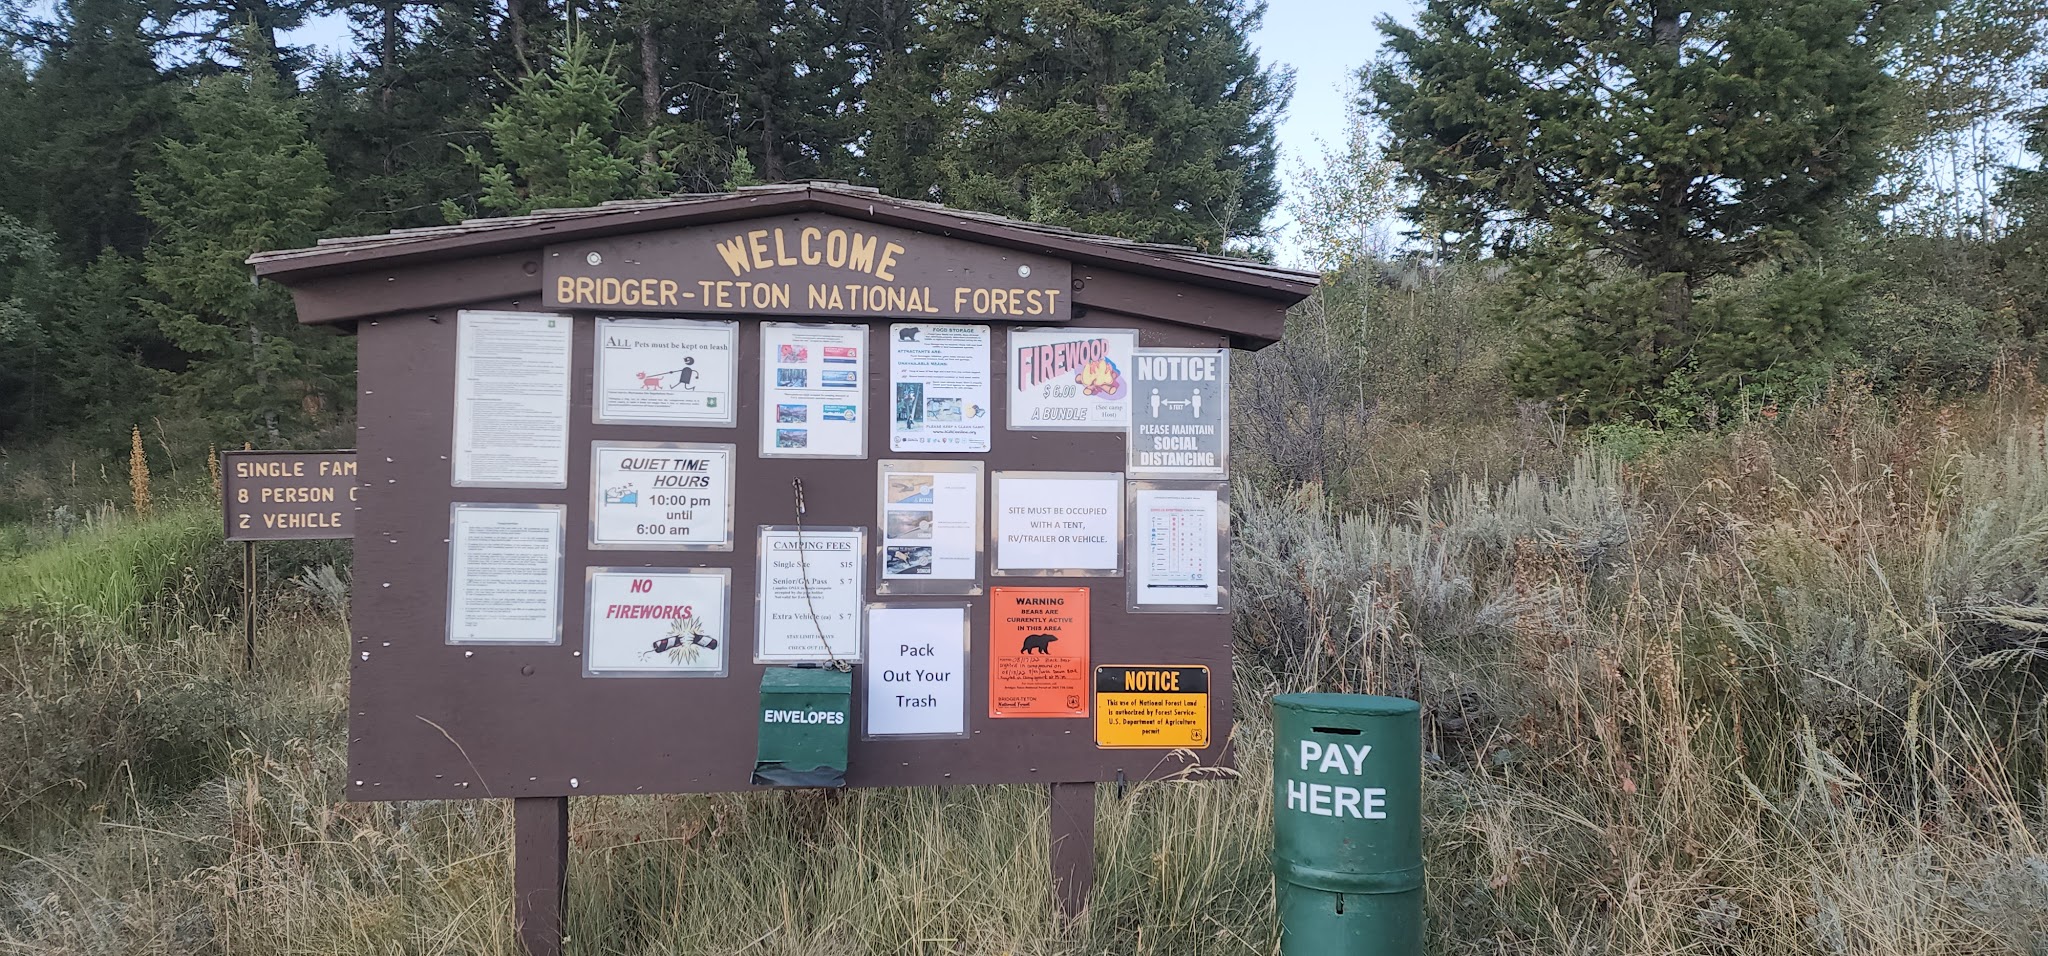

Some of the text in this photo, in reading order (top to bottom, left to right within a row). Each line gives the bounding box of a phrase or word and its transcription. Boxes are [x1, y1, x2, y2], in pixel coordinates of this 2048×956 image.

[716, 227, 905, 282] WELCOME
[557, 276, 1060, 315] BRIDGER-TETON NATIONAL FOREST
[606, 336, 631, 348] ALL
[682, 342, 698, 350] kept
[1018, 338, 1110, 392] FIREWOOD
[1138, 357, 1216, 381] NOTICE
[1043, 384, 1076, 399] $ 6.00
[1031, 407, 1088, 420] A BUNDLE
[1140, 424, 1214, 434] PLEASE MAINTAIN
[1154, 436, 1198, 450] SOCIAL
[620, 458, 710, 470] QUIET TIME
[1140, 452, 1214, 466] DISTANCING
[237, 462, 304, 478] SINGLE
[654, 475, 710, 488] HOURS
[238, 488, 249, 503] 8
[262, 488, 334, 502] PERSON
[649, 495, 710, 508] 10:00 pm
[239, 512, 342, 528] 2 VEHICLE
[666, 510, 693, 520] until
[636, 524, 690, 535] 6:00 am
[1063, 522, 1086, 530] TENT,
[774, 542, 823, 550] CAMPING
[1008, 534, 1056, 544] RV/TRAILER
[630, 579, 652, 593] NO
[1016, 598, 1064, 606] WARNING
[606, 604, 692, 620] FIREWORKS
[900, 644, 935, 657] Pack
[883, 670, 951, 682] Out Your
[1125, 670, 1180, 691] NOTICE
[896, 694, 937, 708] Trash
[764, 710, 844, 724] ENVELOPES
[1300, 740, 1372, 776] PAY
[1288, 779, 1387, 819] HERE
